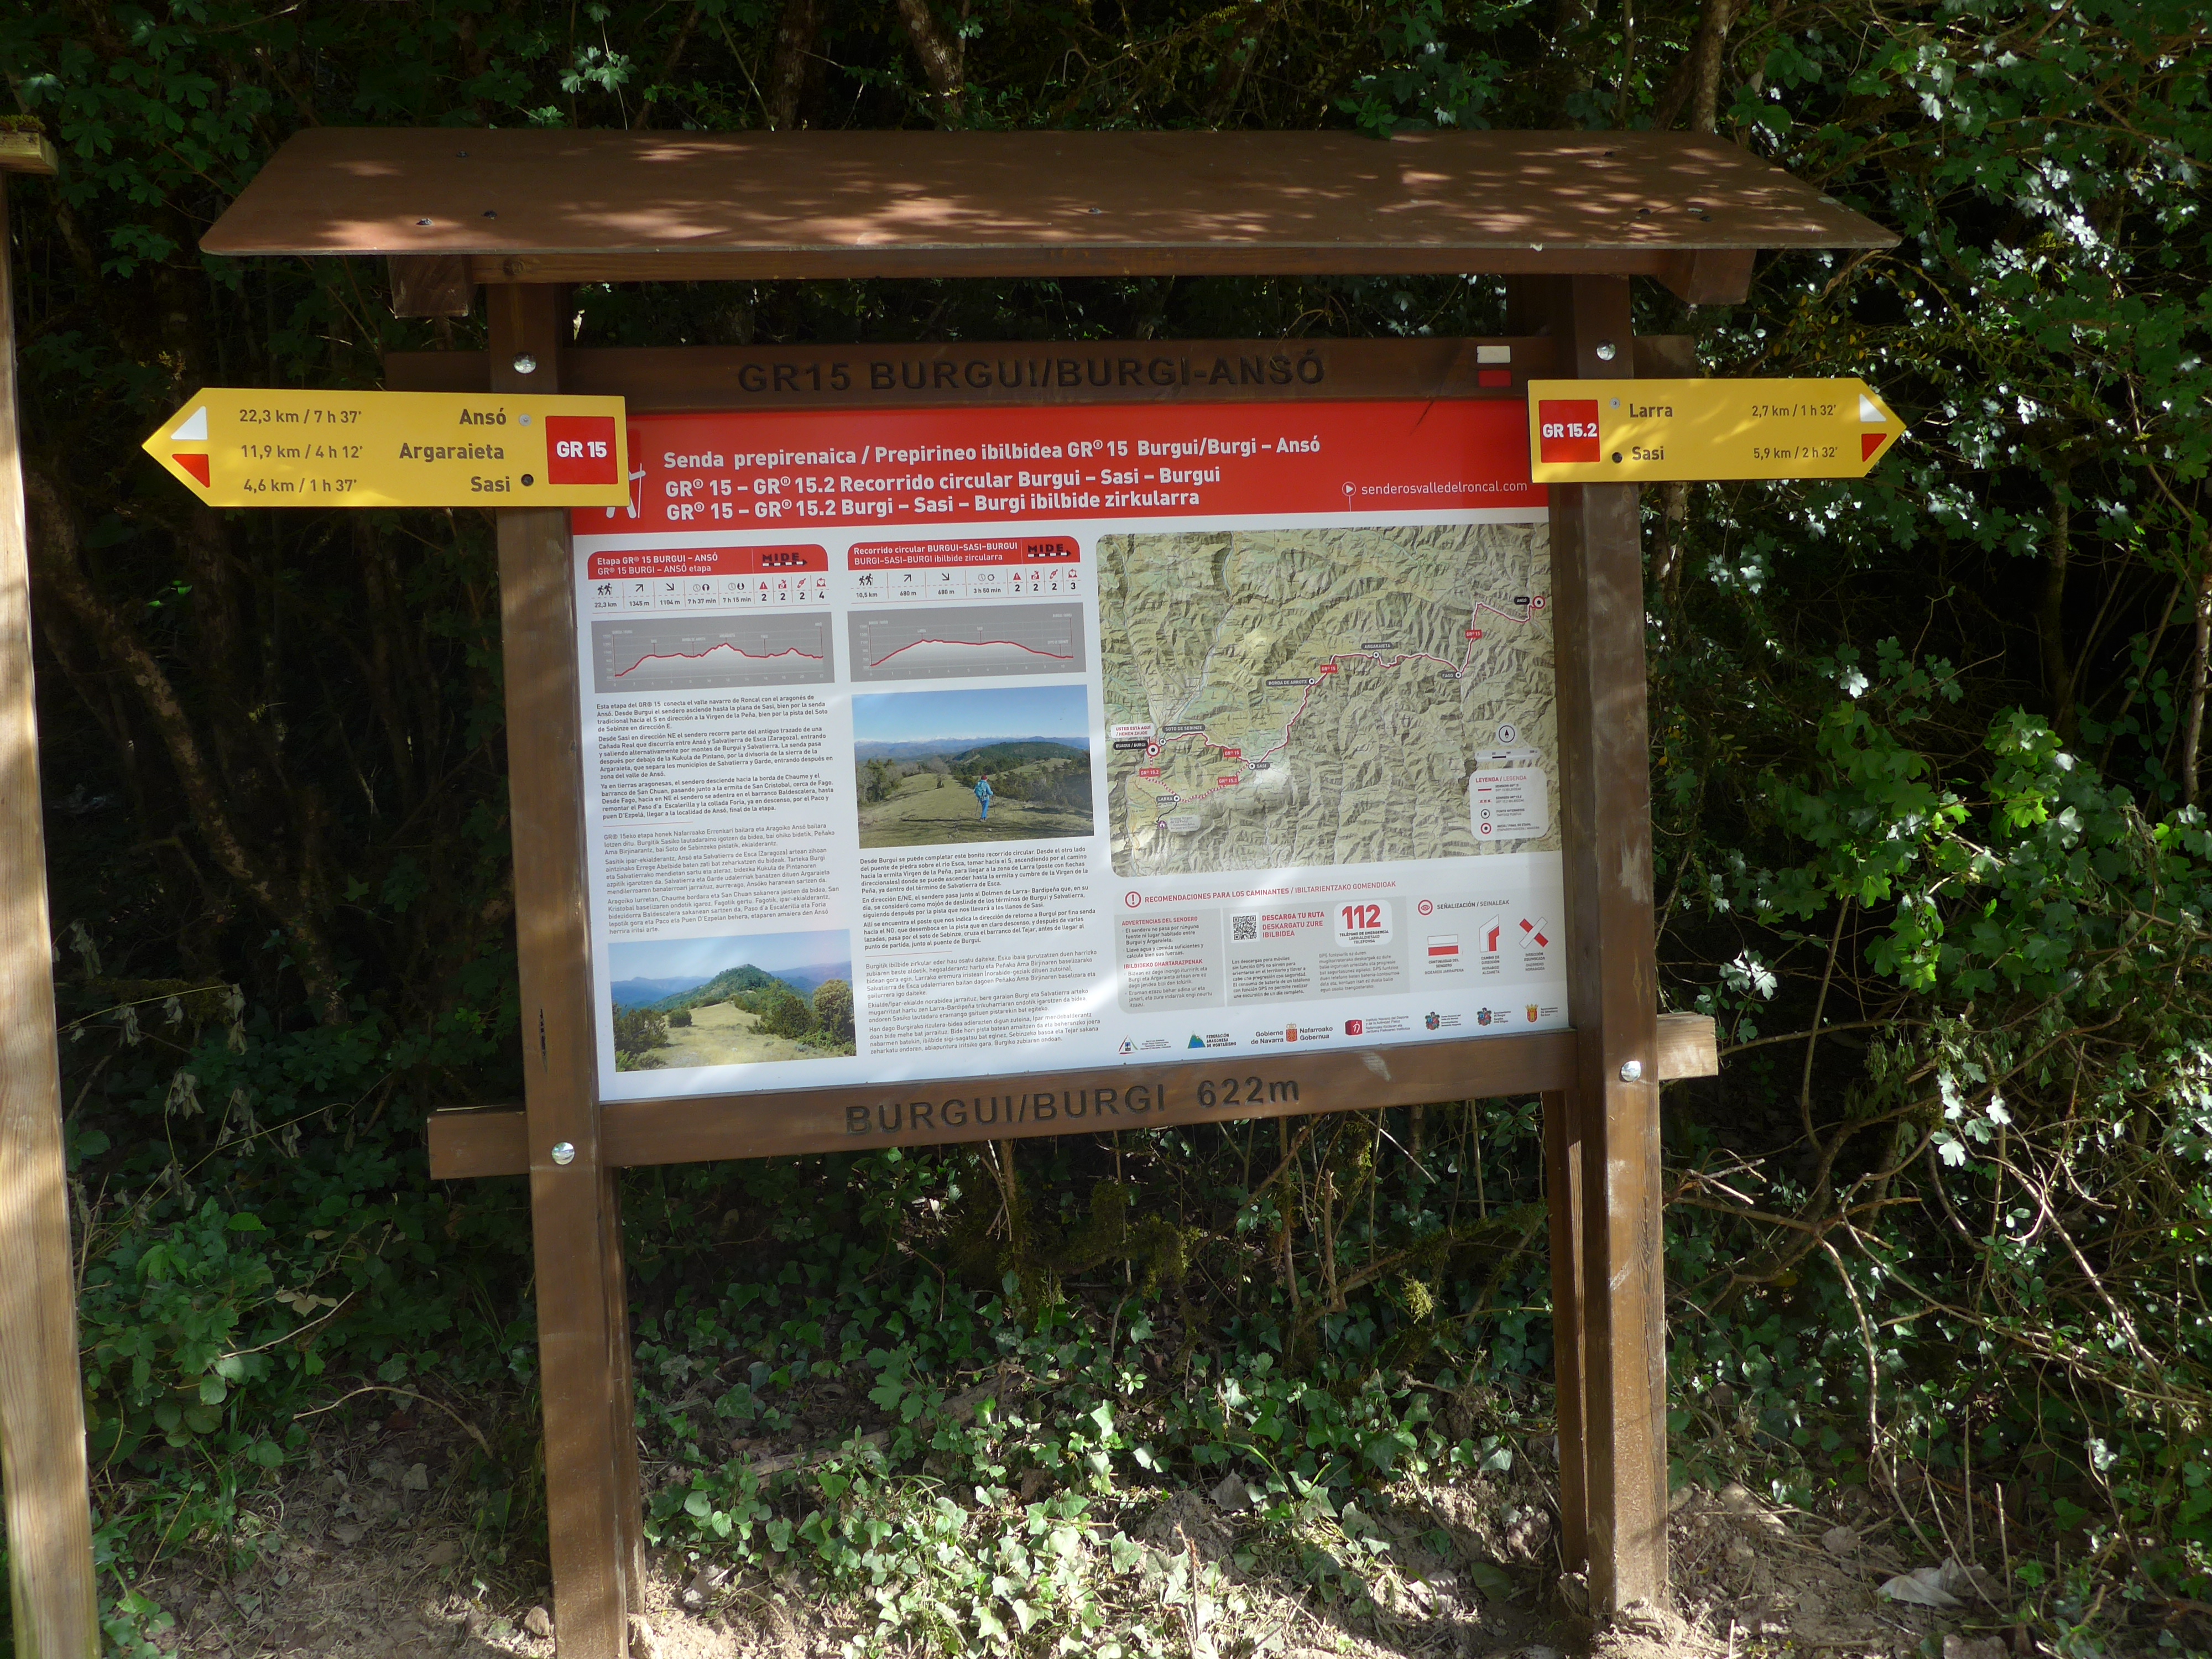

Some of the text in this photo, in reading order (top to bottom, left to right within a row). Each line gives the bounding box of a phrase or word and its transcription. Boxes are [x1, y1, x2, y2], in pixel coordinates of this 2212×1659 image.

[738, 361, 851, 392] GR15
[239, 409, 270, 424] 22,3
[276, 409, 299, 422] km
[314, 410, 322, 422] 7
[327, 410, 335, 422] h
[459, 408, 506, 425] Ansó
[1629, 403, 1672, 418] Larra
[1752, 405, 1768, 418] 2,7
[1772, 405, 1789, 416] km
[1801, 405, 1805, 415] 1
[1811, 404, 1816, 415] h
[1543, 422, 1597, 437] GR 15.2
[241, 445, 272, 460] 11,9
[277, 445, 300, 457] km
[315, 445, 324, 457] 4
[328, 445, 337, 458] h
[399, 442, 504, 462] Argaraieta
[557, 441, 607, 457] GR 15
[664, 451, 723, 468] Senda
[734, 448, 855, 469] prepirenaica
[875, 445, 975, 465] Prepirineo
[982, 442, 1062, 460] ibilbidea
[1107, 440, 1128, 456] 15
[1138, 437, 1256, 458] Burgui/Burgi
[1276, 435, 1319, 452] Ansó
[1632, 446, 1663, 460] Sasi
[1754, 447, 1770, 460] 5,9
[1773, 447, 1791, 458] km
[1802, 447, 1808, 457] 2
[1812, 447, 1818, 457] h
[244, 478, 266, 493] 4,6
[271, 478, 294, 492] km
[310, 479, 316, 492] 1
[322, 479, 331, 492] h
[471, 476, 510, 492] Sasi
[709, 479, 731, 495] 15
[795, 476, 834, 493] 15.2
[840, 474, 933, 492] Recorrido
[940, 472, 1013, 489] circular
[1018, 469, 1079, 489] Burgui
[1101, 468, 1138, 484] Sasi
[1160, 466, 1219, 486] Burgui
[1361, 480, 1527, 494] senderosvalledelroncal.com
[711, 503, 733, 519] 15
[796, 499, 836, 516] 15.2
[842, 498, 893, 517] Burgi
[914, 495, 953, 513] Sasi
[975, 494, 1025, 513] Burgi
[1031, 492, 1100, 509] ibilbide
[1105, 489, 1199, 507] zirkularra
[695, 552, 717, 561] ANSÓ
[664, 563, 686, 572] ANSÓ
[1145, 893, 1211, 902] RECOMENDACIONES
[1246, 888, 1289, 896] CAMINANTES
[1295, 884, 1351, 893] IBILTARIENTZAKO
[1353, 880, 1396, 889] GOMENDIOAK
[1437, 901, 1475, 909] SEÑALIZACIÓN
[1342, 904, 1381, 930] 112
[1262, 921, 1305, 930] DESKARGATU
[846, 1077, 1298, 1135] BURGUI/BURGI 622m
